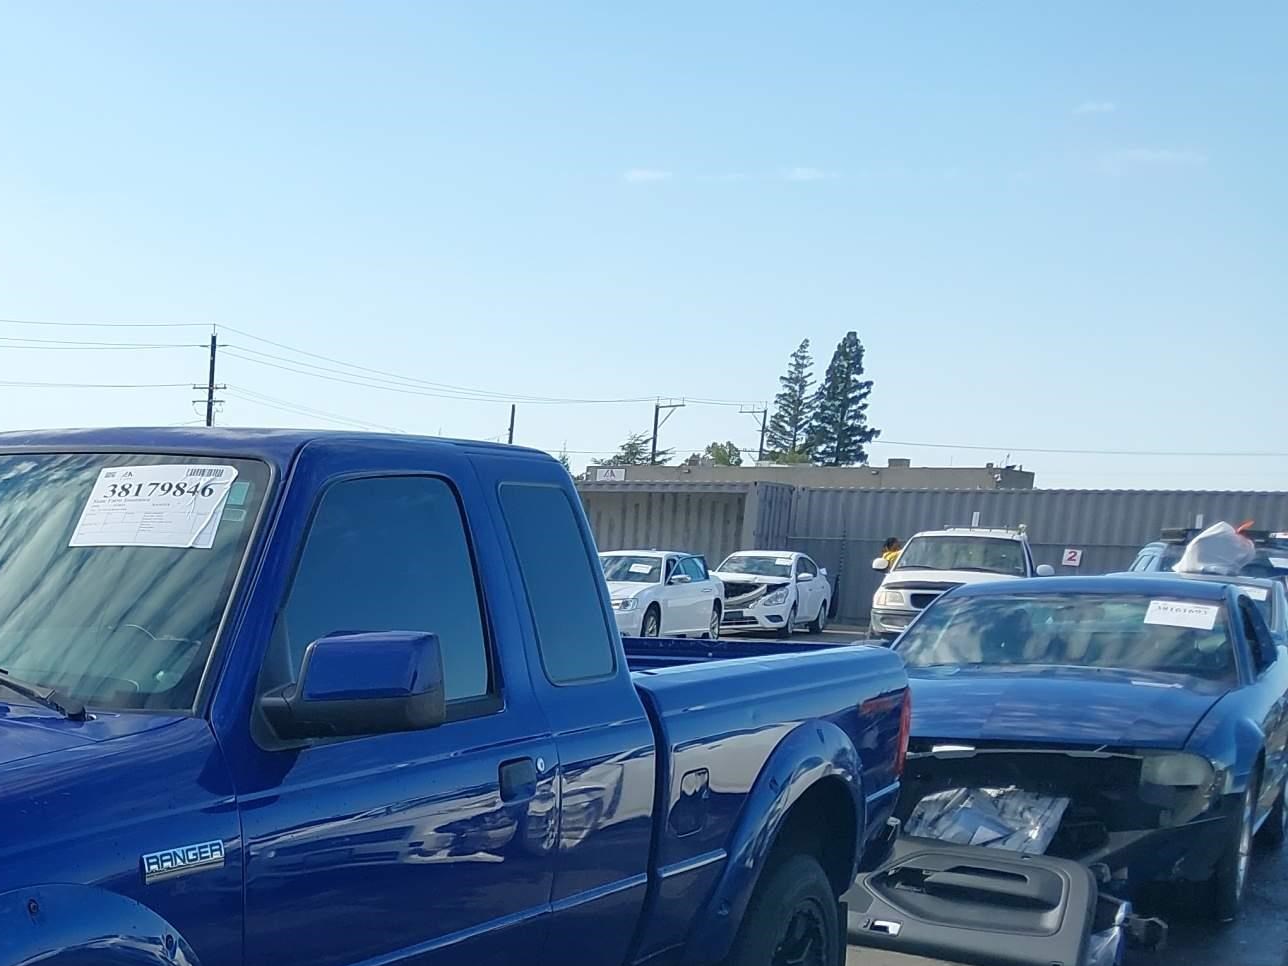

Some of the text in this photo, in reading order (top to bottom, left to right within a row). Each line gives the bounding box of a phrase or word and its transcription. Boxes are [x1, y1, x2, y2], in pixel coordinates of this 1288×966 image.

[103, 482, 214, 499] 38179846
[1067, 550, 1078, 562] 2
[145, 841, 223, 873] RANGER
